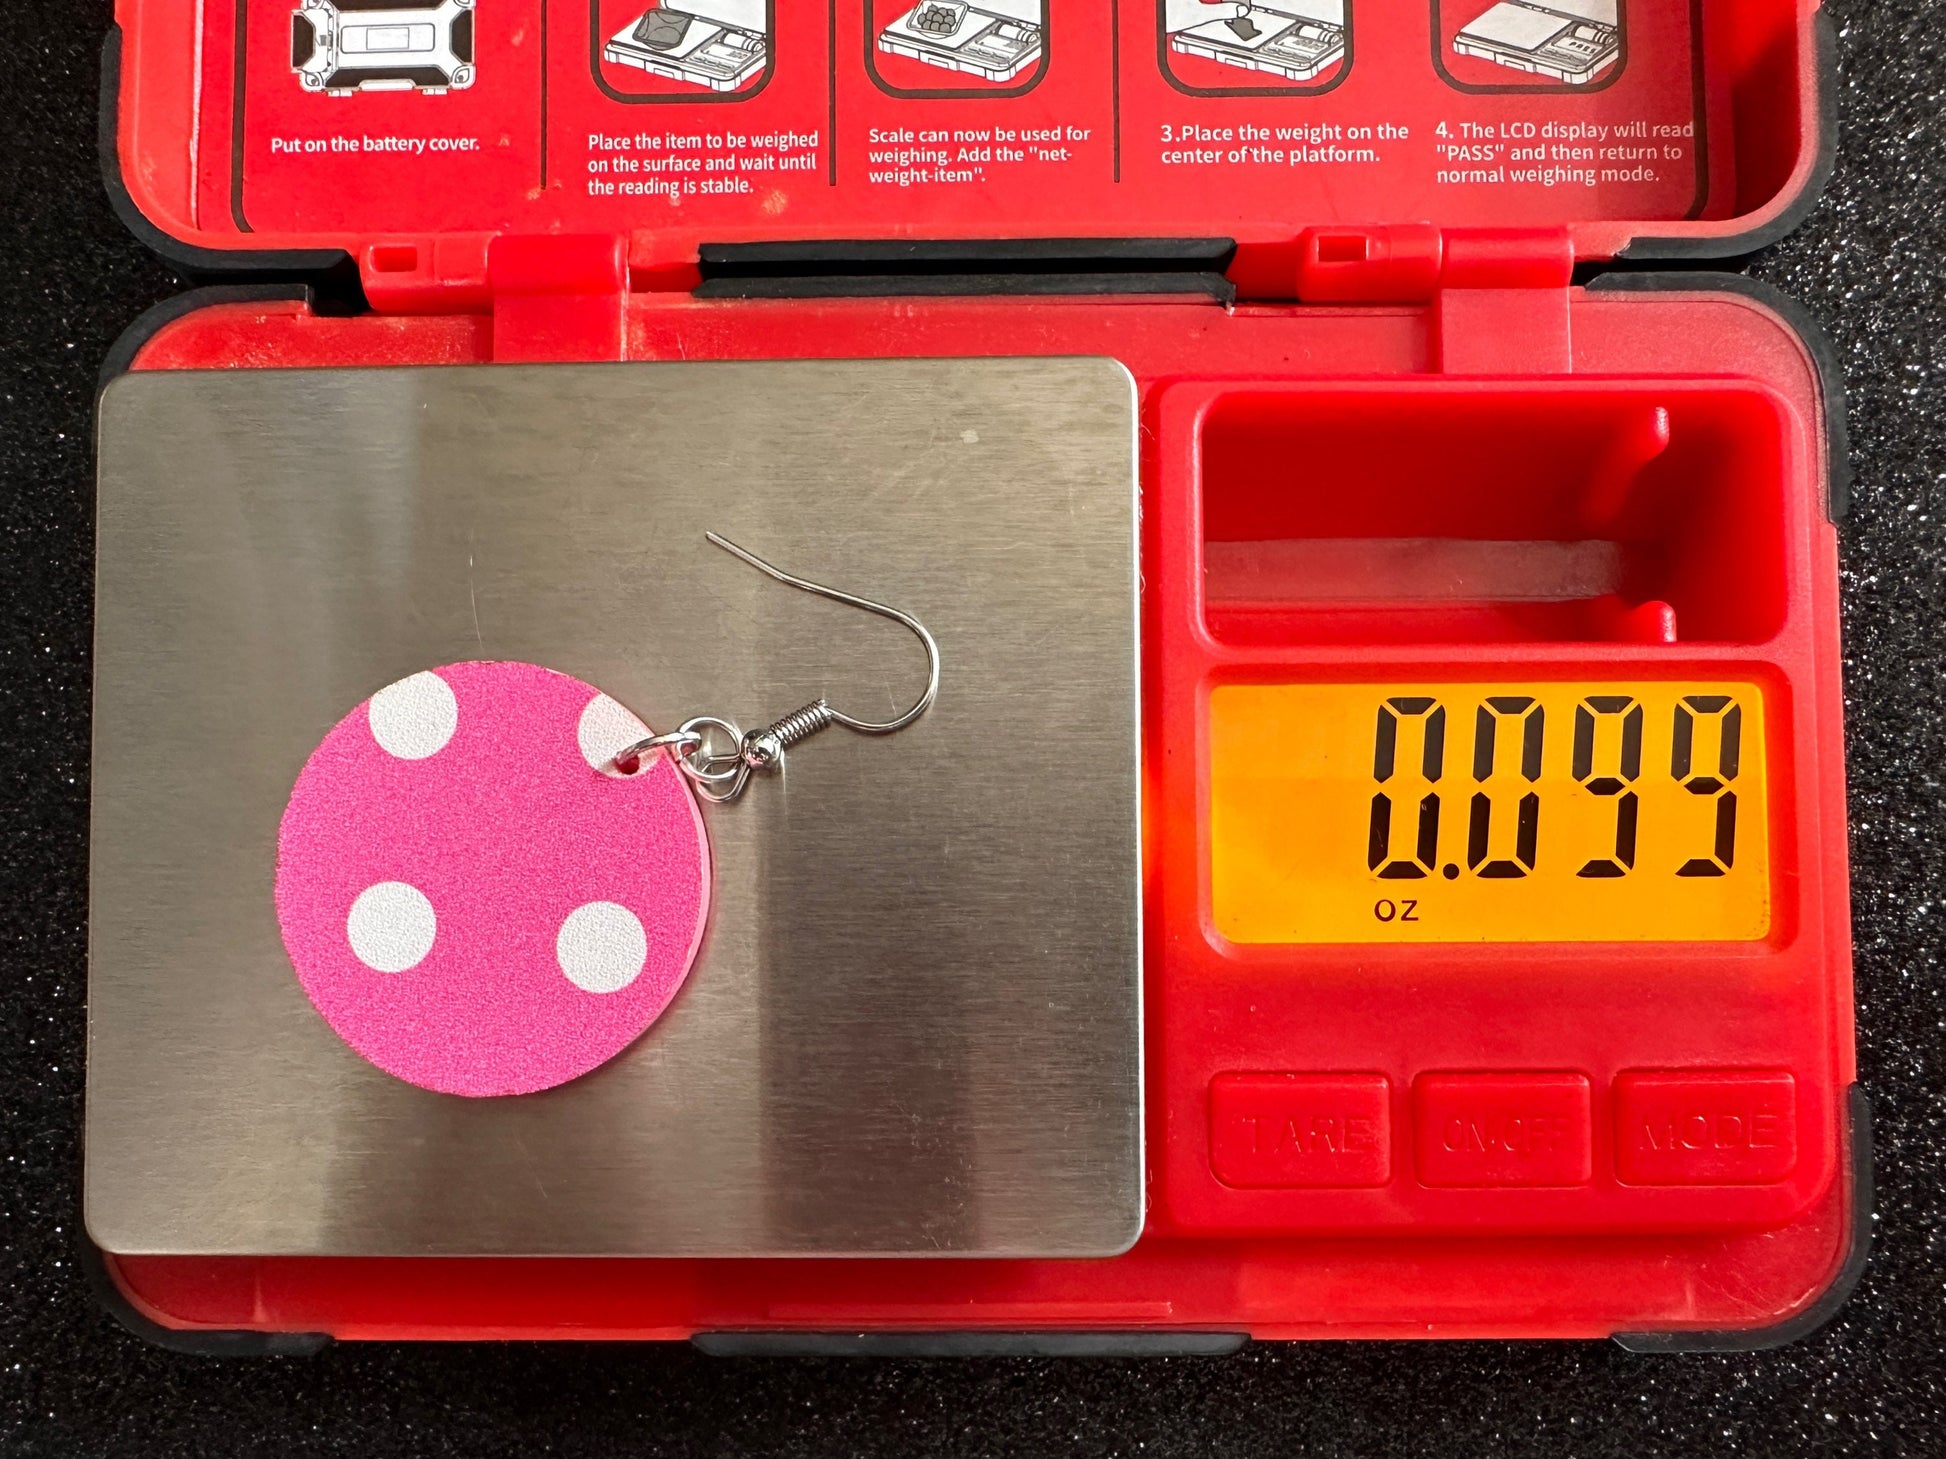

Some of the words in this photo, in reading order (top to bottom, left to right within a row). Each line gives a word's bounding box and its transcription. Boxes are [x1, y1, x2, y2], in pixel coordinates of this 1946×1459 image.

[588, 133, 631, 150] Place
[635, 132, 662, 150] the
[666, 132, 702, 149] item
[705, 133, 723, 149] to
[726, 131, 747, 149] be
[750, 130, 819, 152] weighed
[868, 127, 915, 143] Scale
[918, 130, 949, 143] can
[953, 130, 991, 143] now
[995, 126, 1017, 142] be
[1020, 126, 1062, 142] used
[1065, 125, 1092, 142] for
[1237, 123, 1271, 142] the
[1275, 123, 1343, 144] weight
[1346, 126, 1372, 140] on
[1376, 122, 1410, 140] the
[1434, 121, 1455, 139] 4.
[1458, 121, 1496, 139] The
[1500, 121, 1537, 139] LCD
[1541, 120, 1609, 142] display
[1613, 120, 1648, 138] will
[1652, 121, 1695, 138] read
[271, 137, 302, 153] Put
[304, 139, 327, 153] on
[330, 136, 360, 152] the
[363, 135, 427, 155] battery
[429, 137, 480, 152] cover.
[1160, 147, 1224, 164] center
[1228, 145, 1249, 164] of
[1251, 146, 1285, 164] the
[1289, 146, 1381, 167] platform.
[1436, 143, 1505, 162] "PASS"
[1510, 143, 1547, 161] and
[1550, 143, 1594, 161] then
[1599, 145, 1658, 161] return
[1663, 145, 1682, 160] to
[587, 159, 609, 173] on
[612, 155, 640, 173] the
[643, 154, 702, 172] surface
[705, 153, 736, 171] and
[739, 153, 775, 171] wait
[778, 152, 817, 170] until
[868, 147, 953, 167] weighing.
[956, 146, 992, 163] Add
[995, 146, 1025, 162] the
[1028, 146, 1073, 162] "net-
[868, 167, 986, 187] weight-item".
[1437, 165, 1505, 183] normal
[1509, 164, 1597, 187] weighing
[1600, 165, 1660, 182] mode.
[587, 178, 615, 195] the
[618, 177, 681, 200] reading
[683, 176, 697, 194] is
[700, 176, 754, 194] stable.
[1368, 695, 1742, 880] 0.099
[1241, 1114, 1371, 1153] TARE
[1640, 1113, 1778, 1151] MODE
